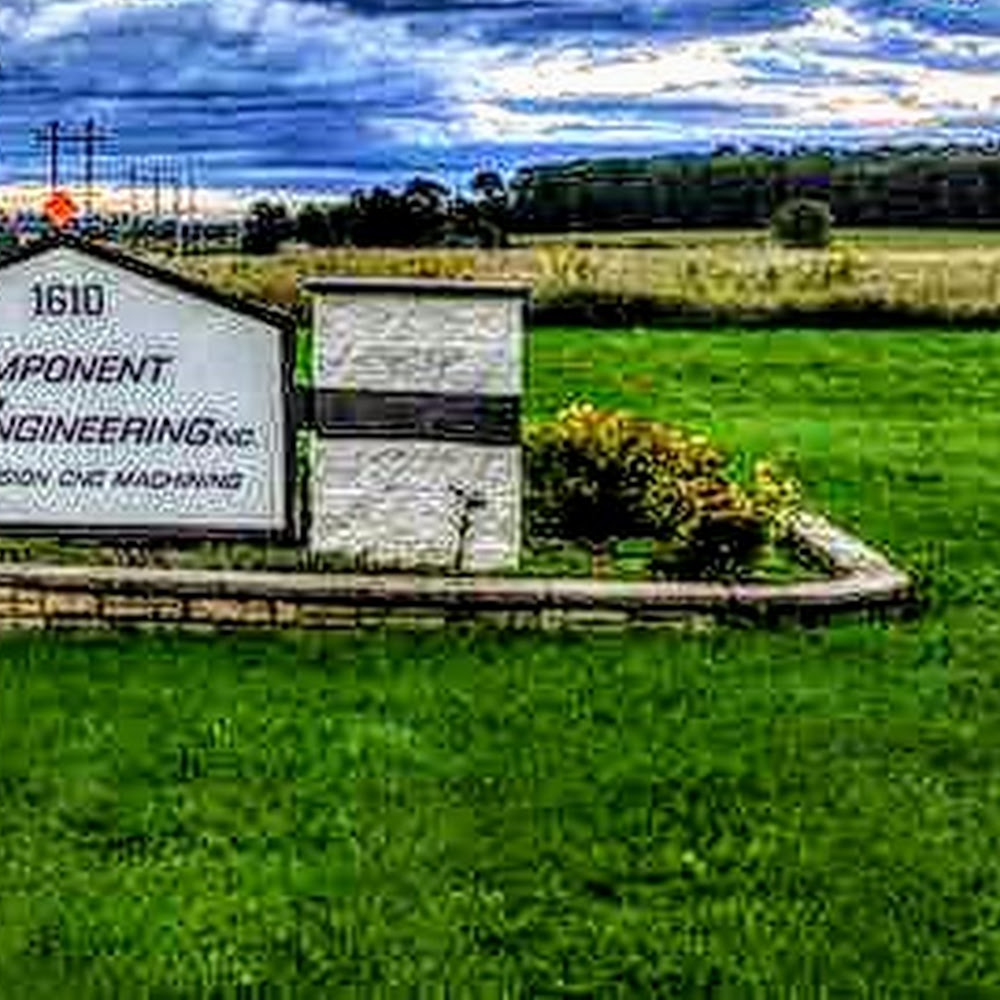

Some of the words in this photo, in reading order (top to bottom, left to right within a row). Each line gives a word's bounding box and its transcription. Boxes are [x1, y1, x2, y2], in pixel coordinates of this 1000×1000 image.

[31, 284, 104, 316] 1610
[58, 470, 105, 489] CNC
[112, 471, 244, 491] MACHINING
